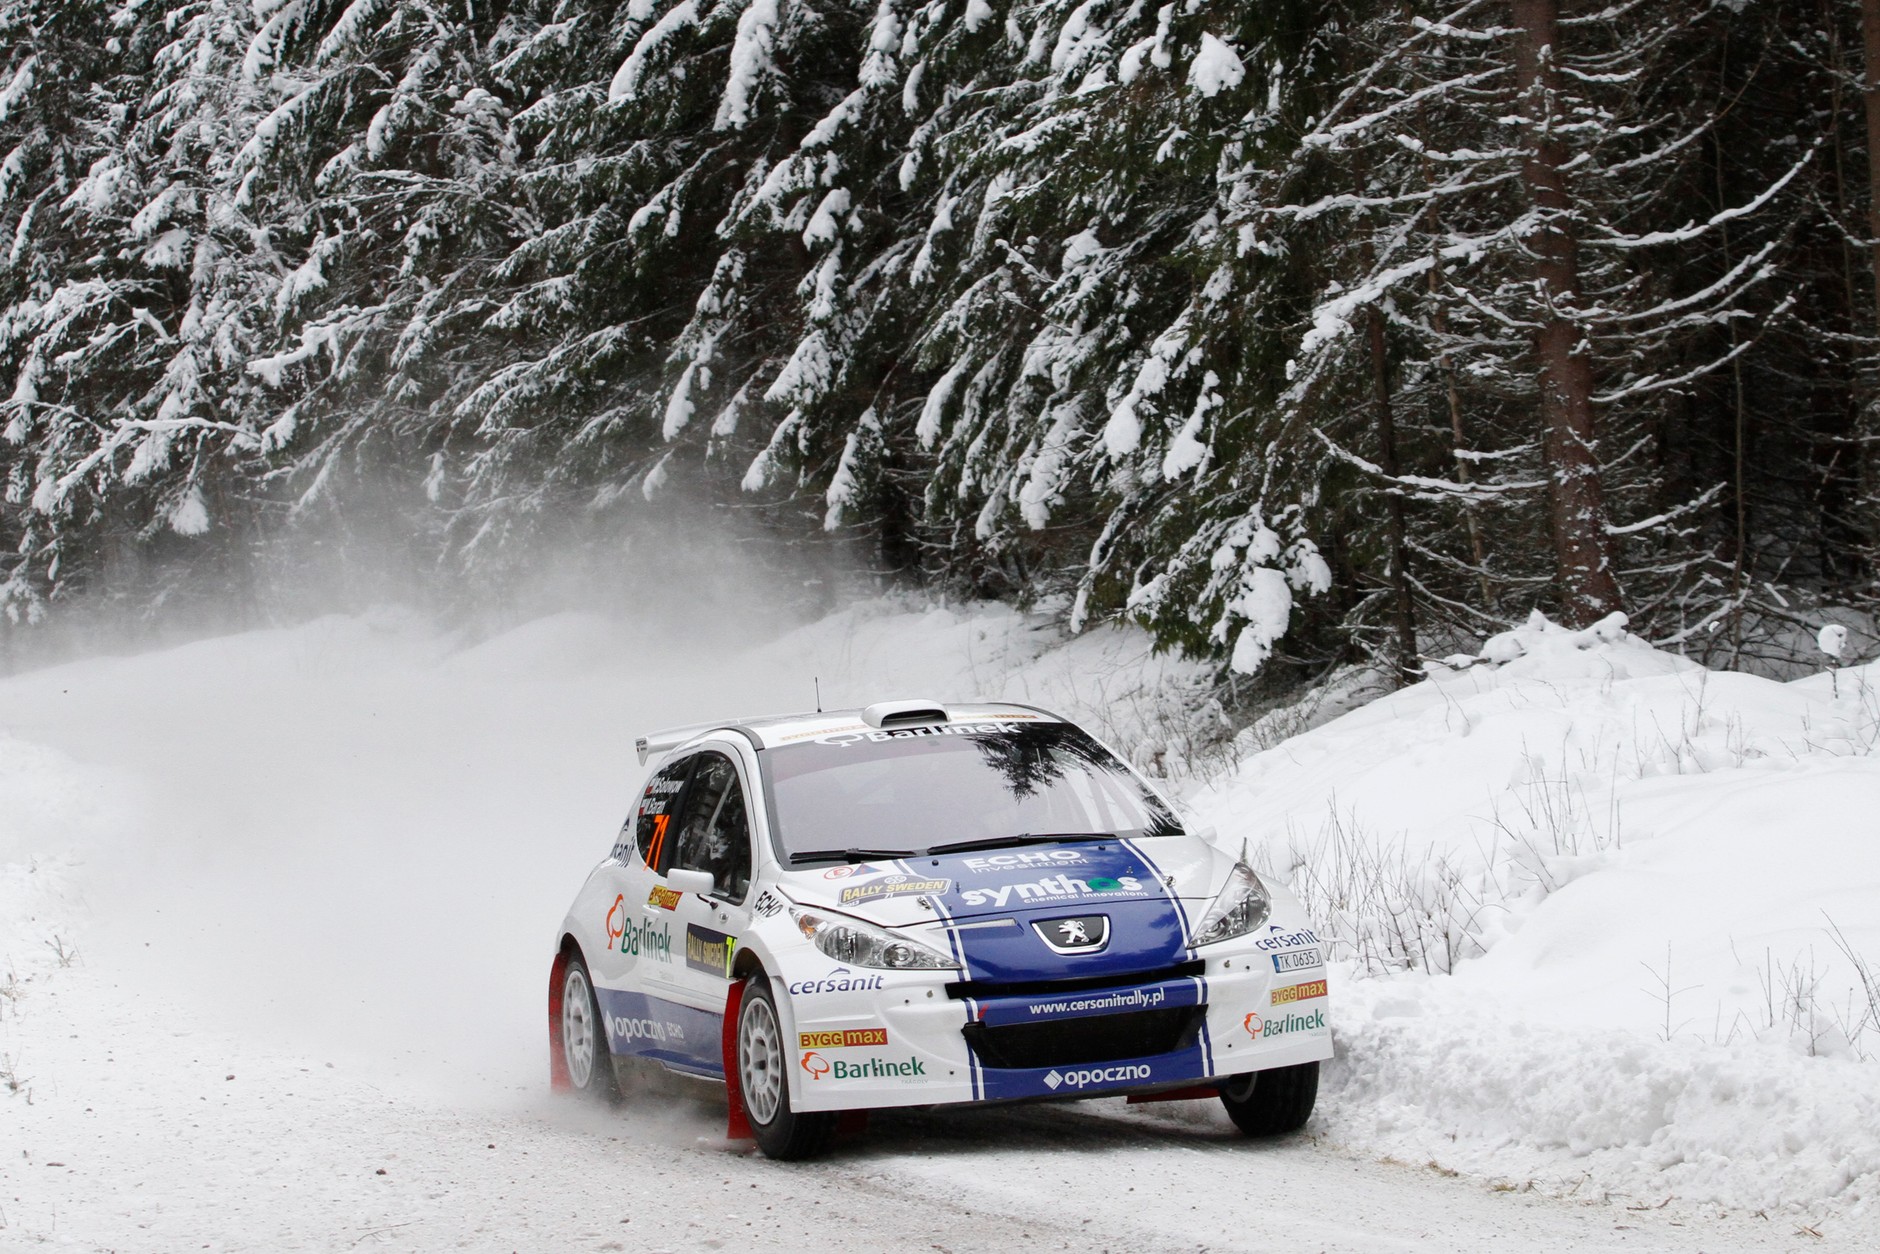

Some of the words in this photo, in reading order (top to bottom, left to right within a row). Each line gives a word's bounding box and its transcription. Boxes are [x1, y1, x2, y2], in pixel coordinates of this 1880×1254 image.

[869, 722, 1022, 743] Barlinek
[643, 814, 670, 871] 71
[962, 850, 1081, 869] ECHO
[843, 885, 883, 902] RALLY
[886, 881, 944, 892] SWEDEN
[961, 874, 1143, 907] synthos
[1024, 893, 1079, 904] chemical
[1082, 889, 1149, 899] innovations
[754, 890, 784, 918] ECHO
[621, 918, 671, 963] Barlinek
[1255, 928, 1320, 950] cersanit
[1279, 955, 1291, 968] TK
[1293, 951, 1321, 967] 0635J
[790, 974, 884, 995] cersanit
[1030, 987, 1164, 1014] www.cersanitrally.pl
[615, 1017, 665, 1043] opoczno
[1263, 1009, 1325, 1037] Barlinek
[833, 1056, 926, 1079] Barlinek
[1065, 1064, 1151, 1088] opoczno
